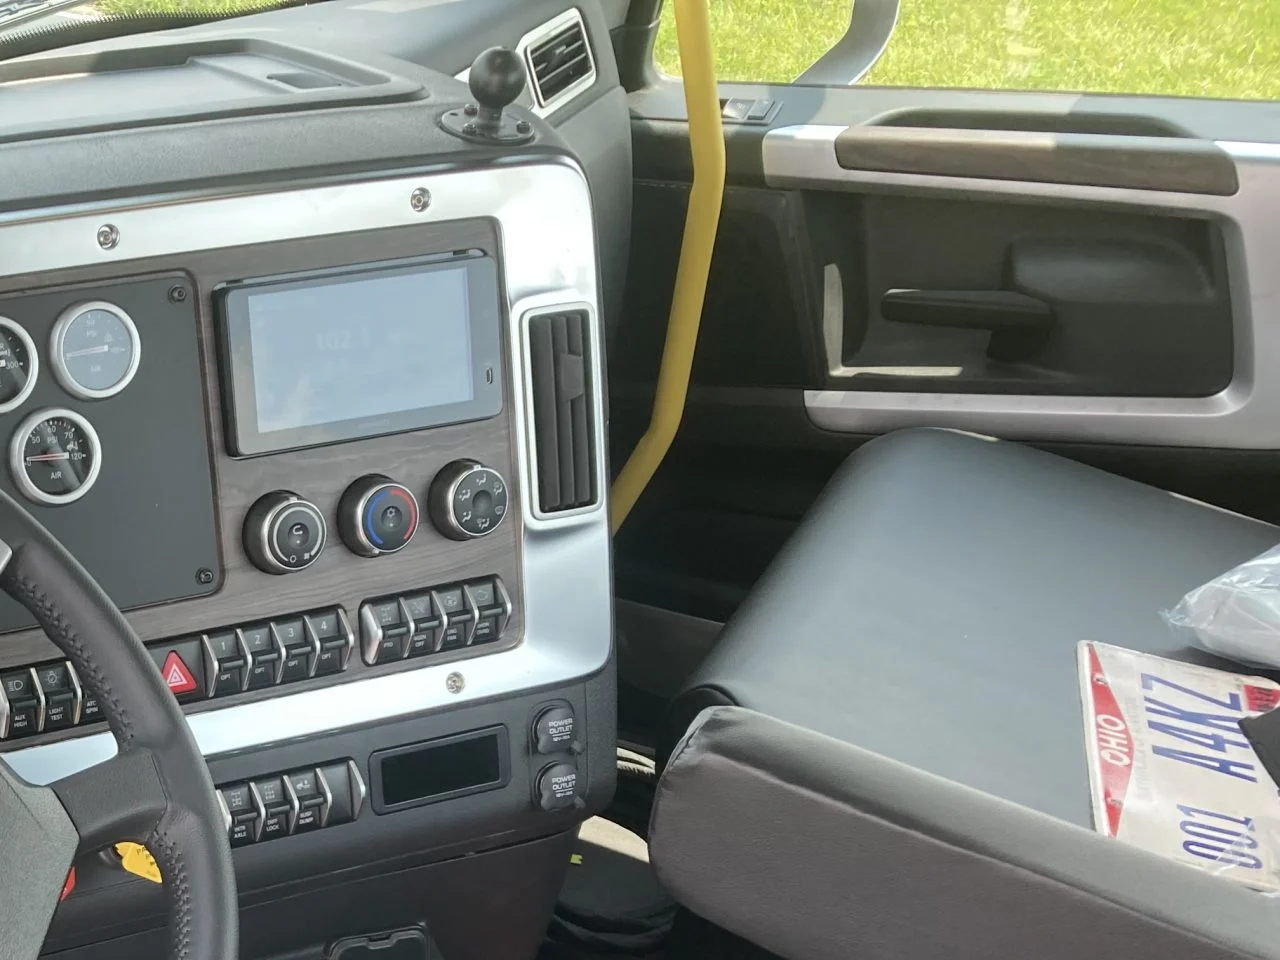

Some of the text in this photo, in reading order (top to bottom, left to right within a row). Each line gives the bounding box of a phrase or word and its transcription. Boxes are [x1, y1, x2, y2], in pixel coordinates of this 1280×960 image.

[0, 342, 5, 350] R
[6, 361, 19, 370] 300
[47, 425, 57, 433] 60
[31, 435, 41, 444] 50
[47, 435, 58, 444] PSI
[64, 431, 74, 440] 70
[71, 452, 83, 461] 120
[50, 470, 63, 480] AIR
[321, 620, 328, 630] 4
[288, 627, 294, 638] 3
[255, 634, 261, 645] 2
[221, 641, 226, 651] 1
[49, 706, 64, 715] LIGHT
[548, 717, 573, 728] POWER
[549, 725, 573, 735] OUTLET
[1096, 713, 1131, 768] OHIO
[1140, 672, 1264, 871] 001 A4KZ
[551, 773, 576, 784] POWER
[552, 781, 576, 791] OUTLET
[266, 824, 280, 832] LOCK
